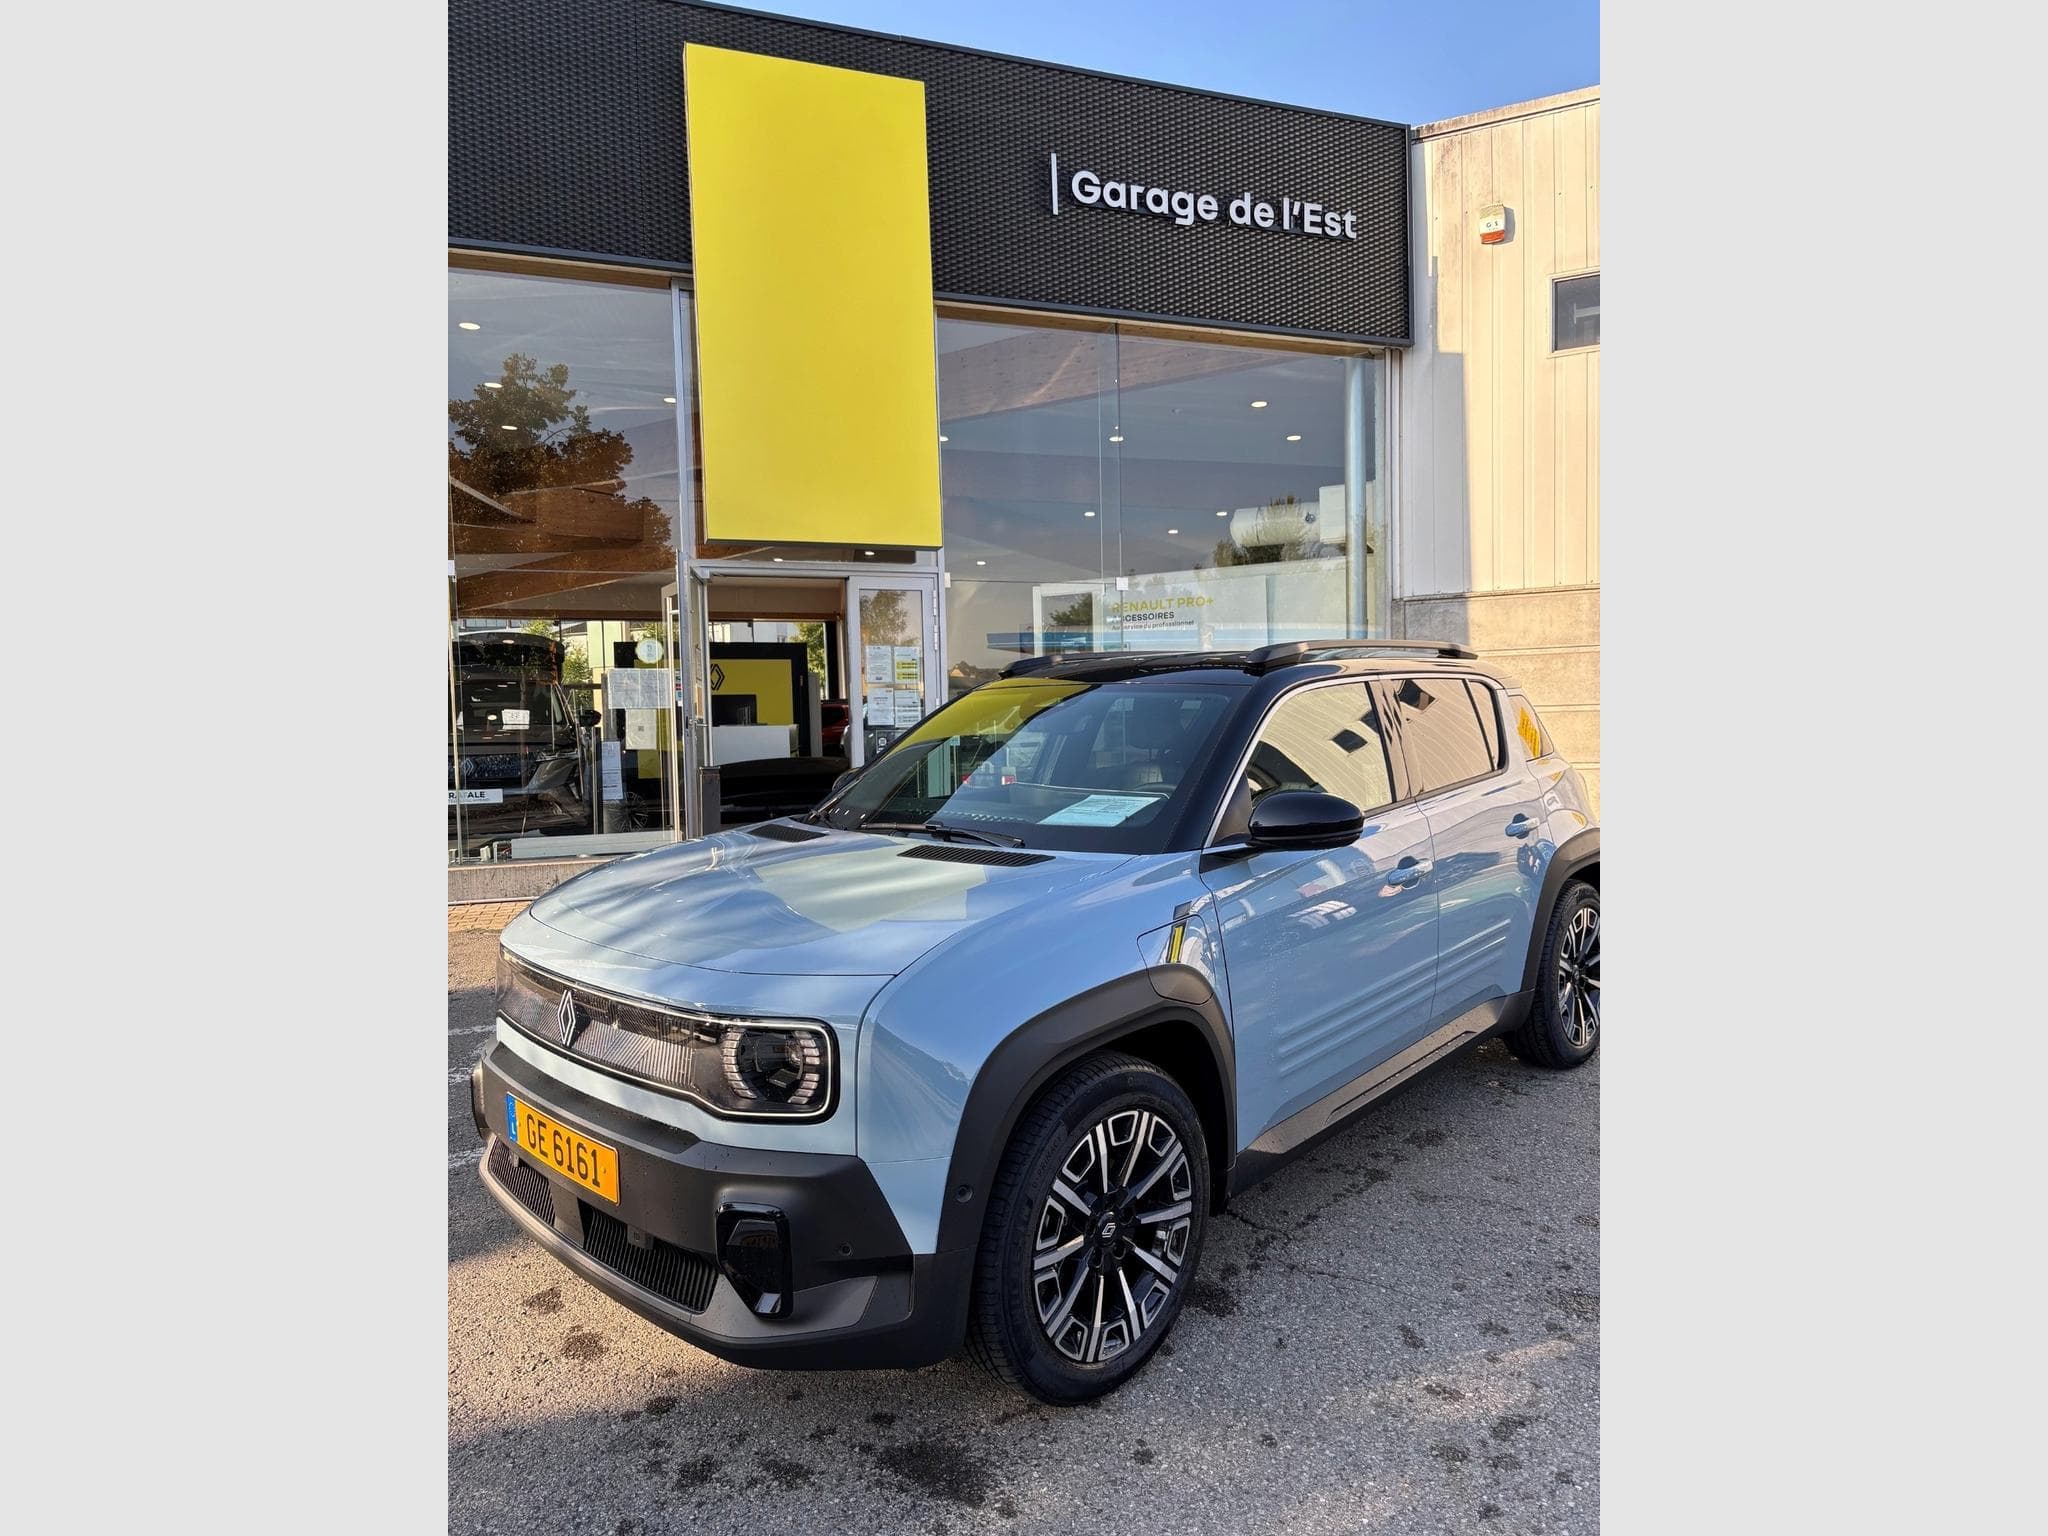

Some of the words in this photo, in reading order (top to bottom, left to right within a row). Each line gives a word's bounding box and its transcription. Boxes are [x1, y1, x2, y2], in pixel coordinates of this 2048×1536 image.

[1071, 170, 1218, 225] Garage
[1229, 192, 1275, 228] de
[1283, 197, 1357, 239] l'Est
[1112, 598, 1174, 613] RENAULT
[1177, 595, 1214, 608] PRO+
[526, 1113, 549, 1158] GE
[553, 1129, 601, 1188] 6161
